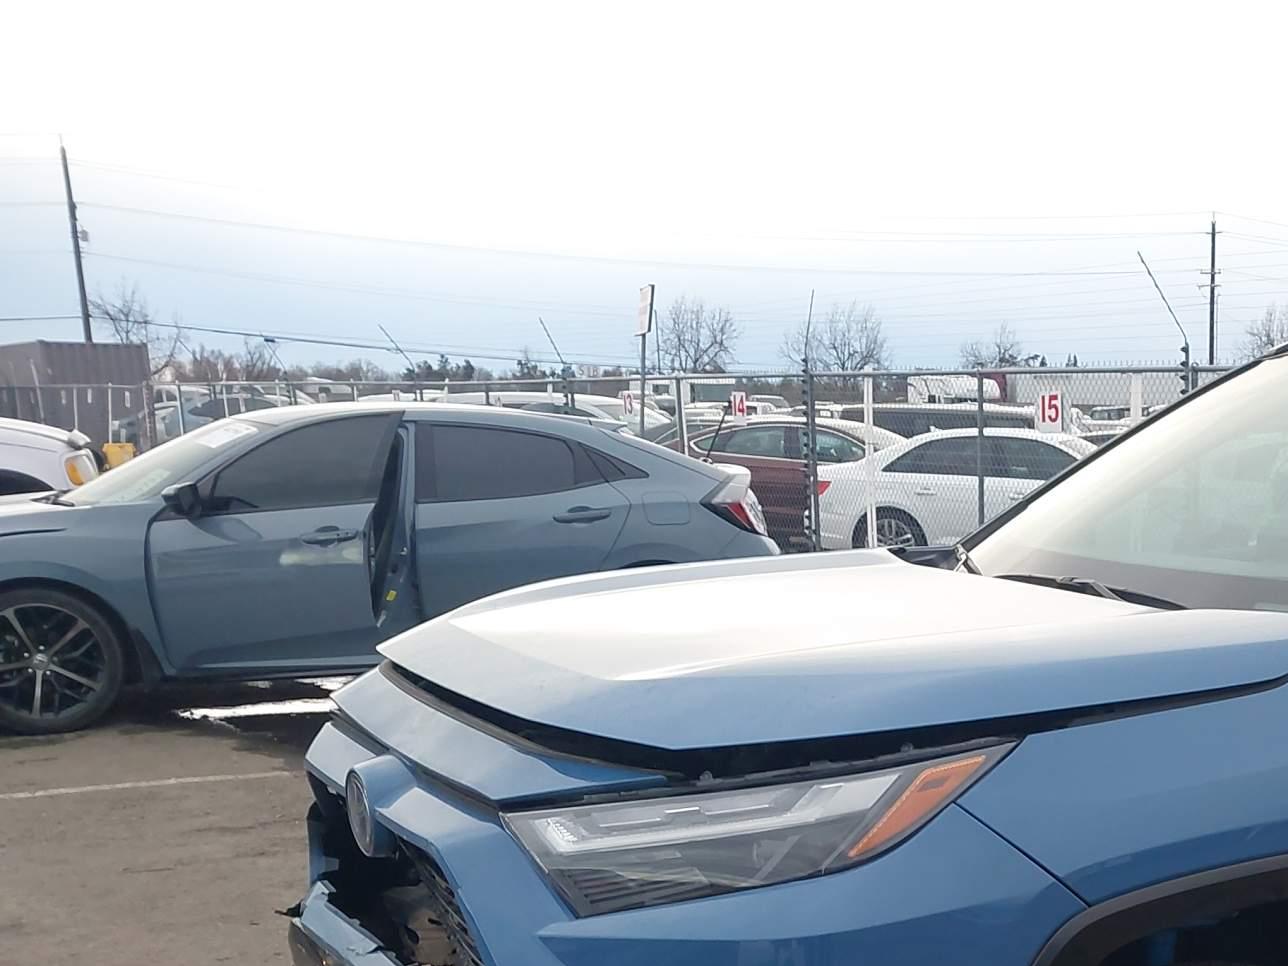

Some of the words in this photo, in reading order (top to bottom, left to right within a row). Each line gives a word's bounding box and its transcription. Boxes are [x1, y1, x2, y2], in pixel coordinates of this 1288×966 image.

[623, 393, 633, 415] 13
[732, 393, 746, 416] 14
[1041, 394, 1060, 423] 15
